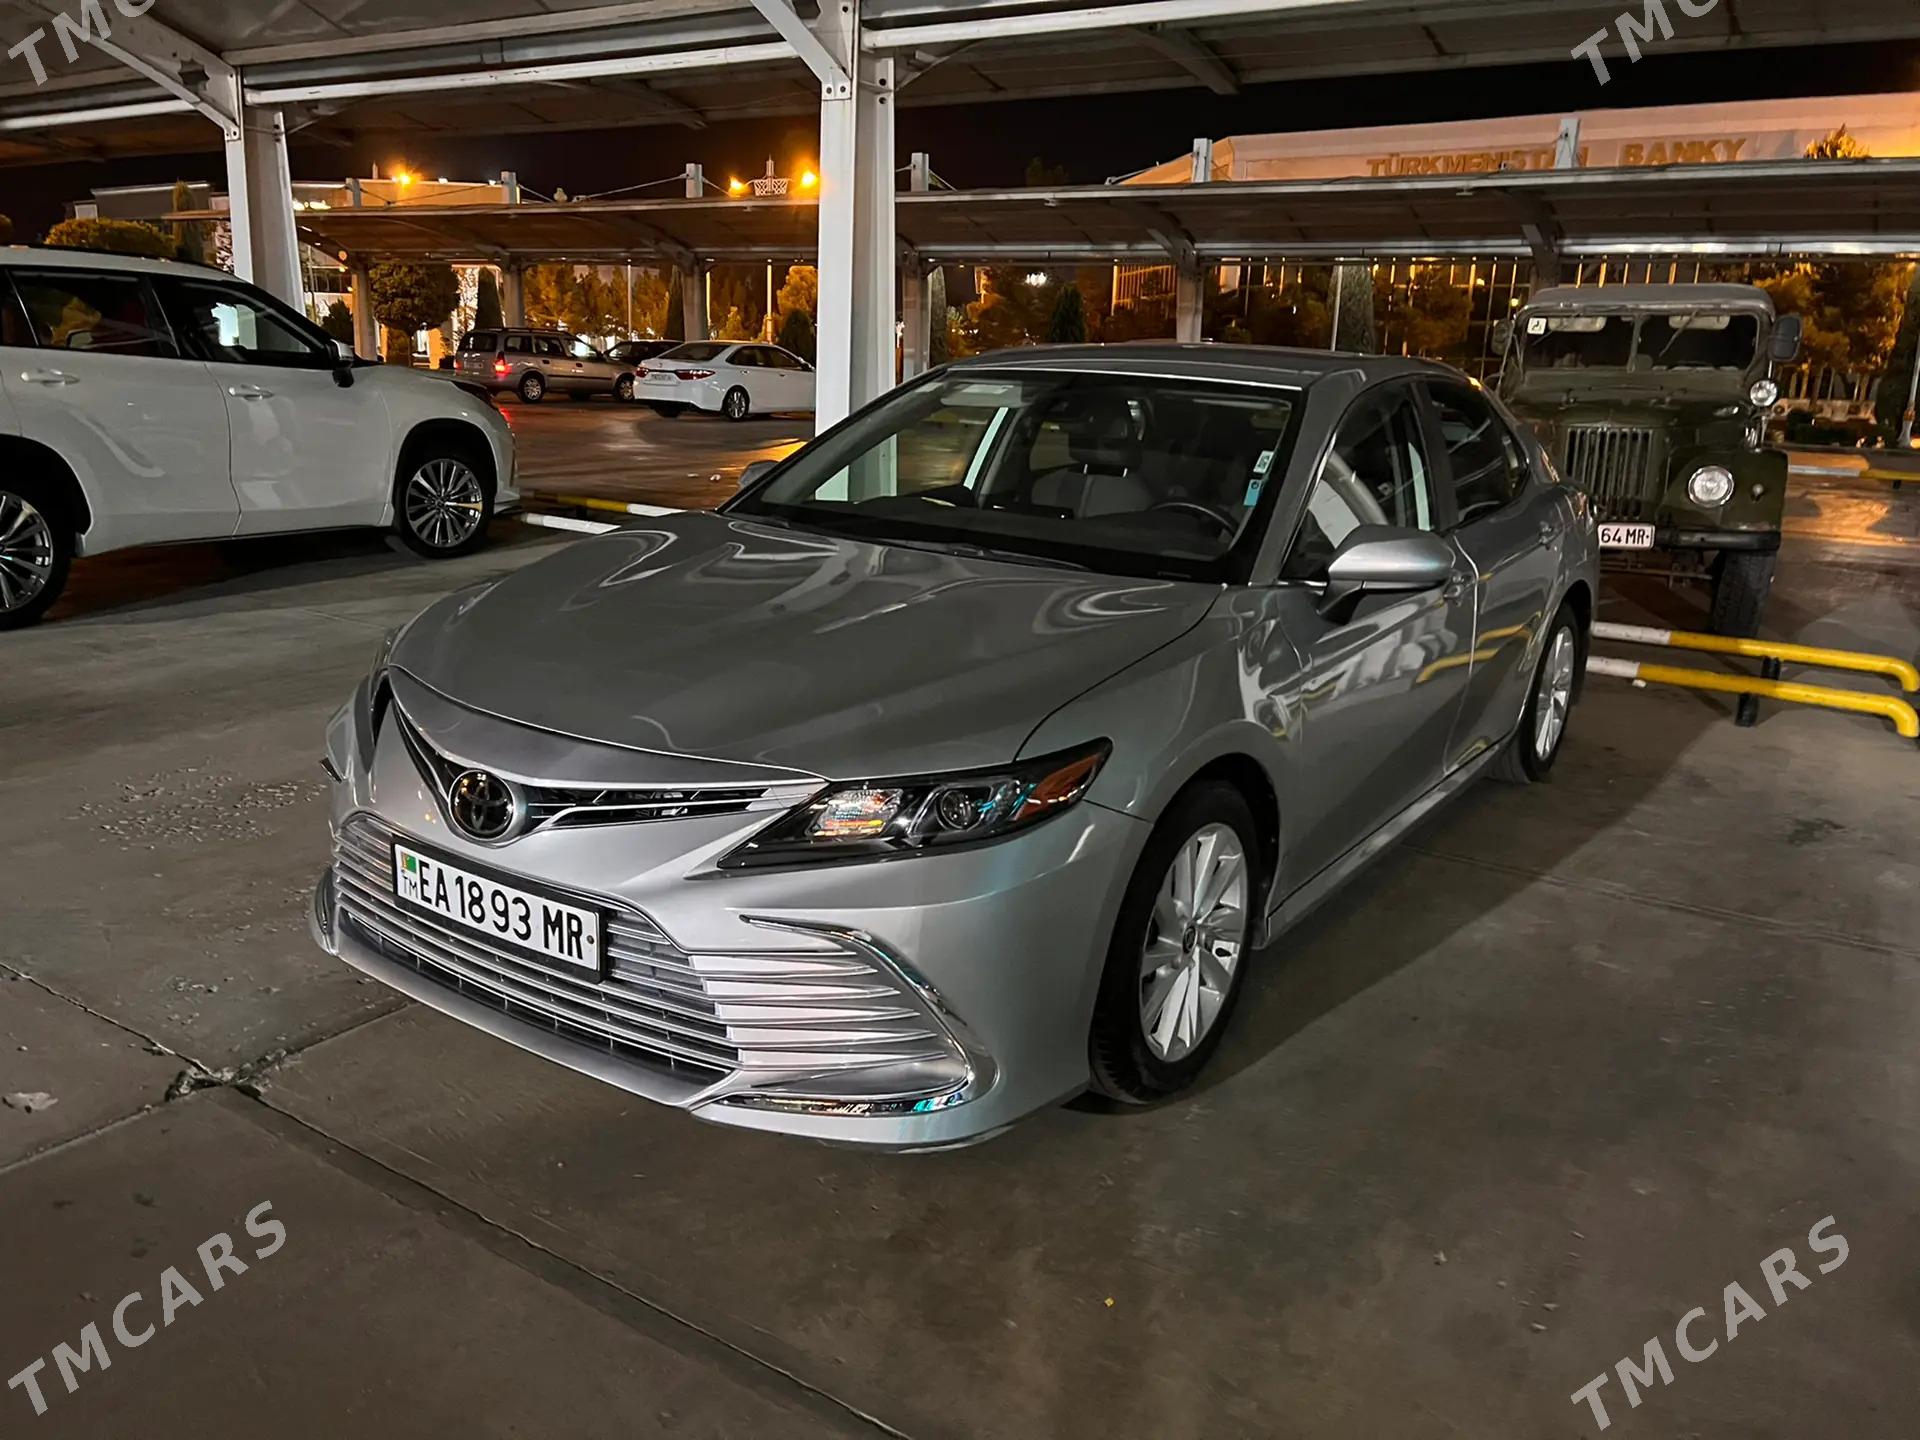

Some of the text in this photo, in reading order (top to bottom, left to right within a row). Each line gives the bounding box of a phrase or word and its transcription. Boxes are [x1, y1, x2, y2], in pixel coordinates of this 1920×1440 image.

[1620, 138, 1747, 167] BANKY
[1625, 528, 1646, 545] MR
[401, 874, 419, 900] TM
[542, 904, 584, 961] MR
